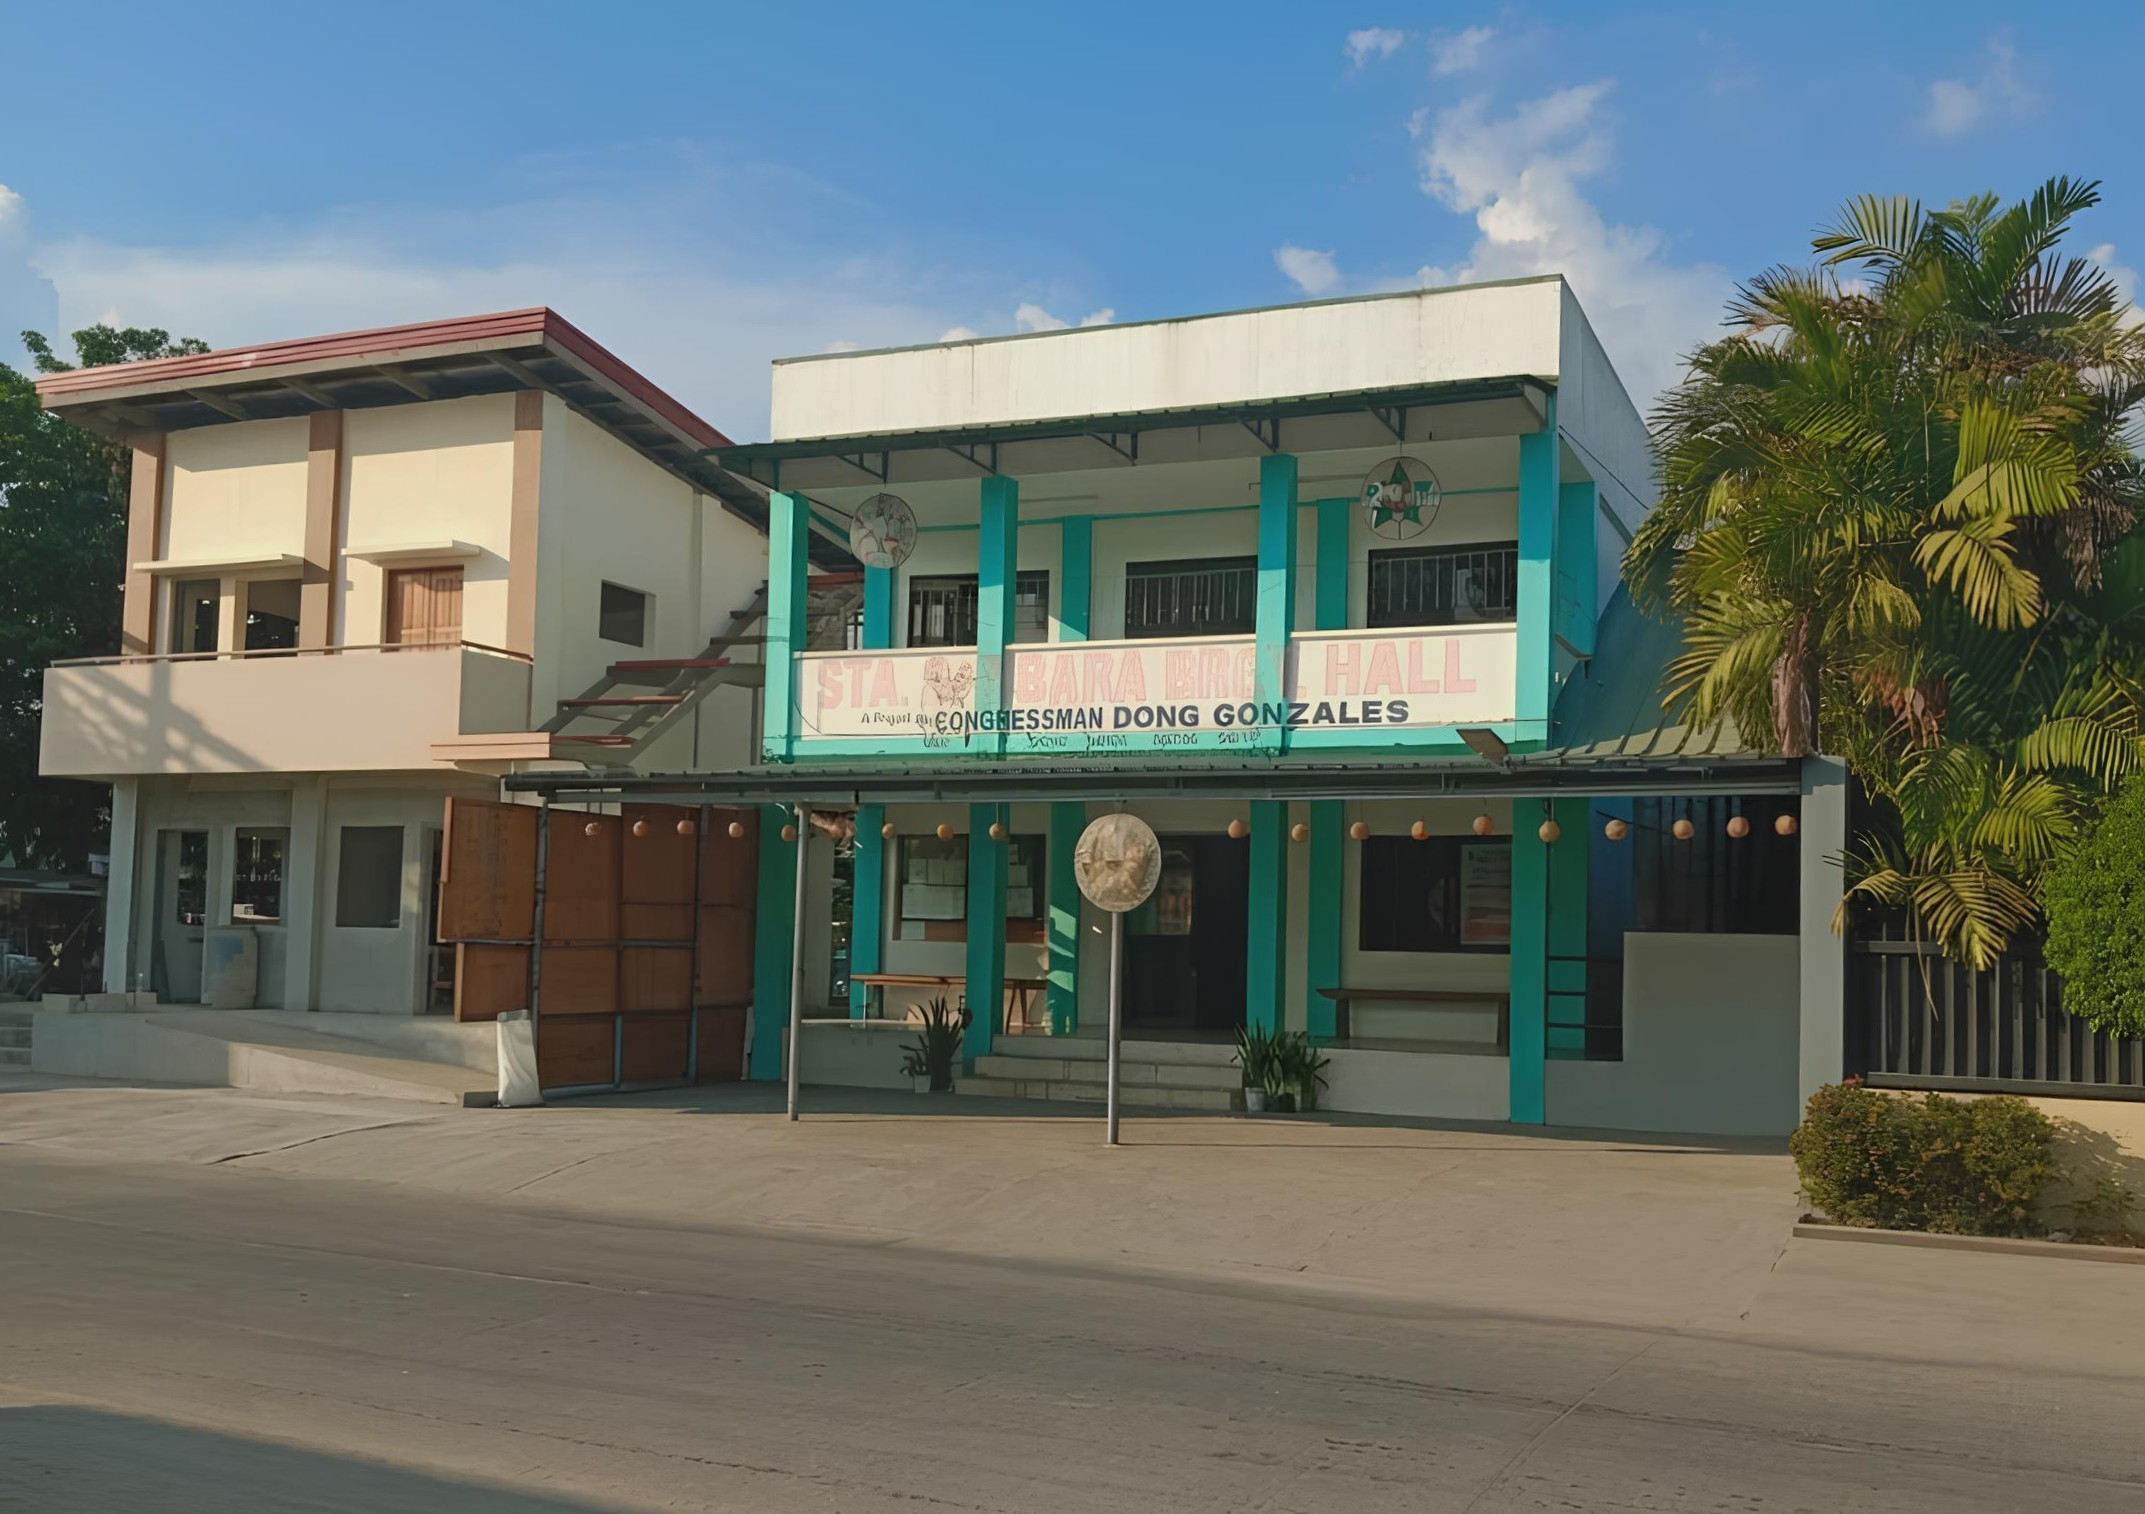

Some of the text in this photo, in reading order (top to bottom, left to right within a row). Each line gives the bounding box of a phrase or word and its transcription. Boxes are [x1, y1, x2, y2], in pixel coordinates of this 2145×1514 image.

[818, 657, 908, 709] STA.
[1325, 639, 1476, 696] HALL
[1113, 703, 1199, 729] DONG
[1213, 699, 1409, 727] GONZALES
